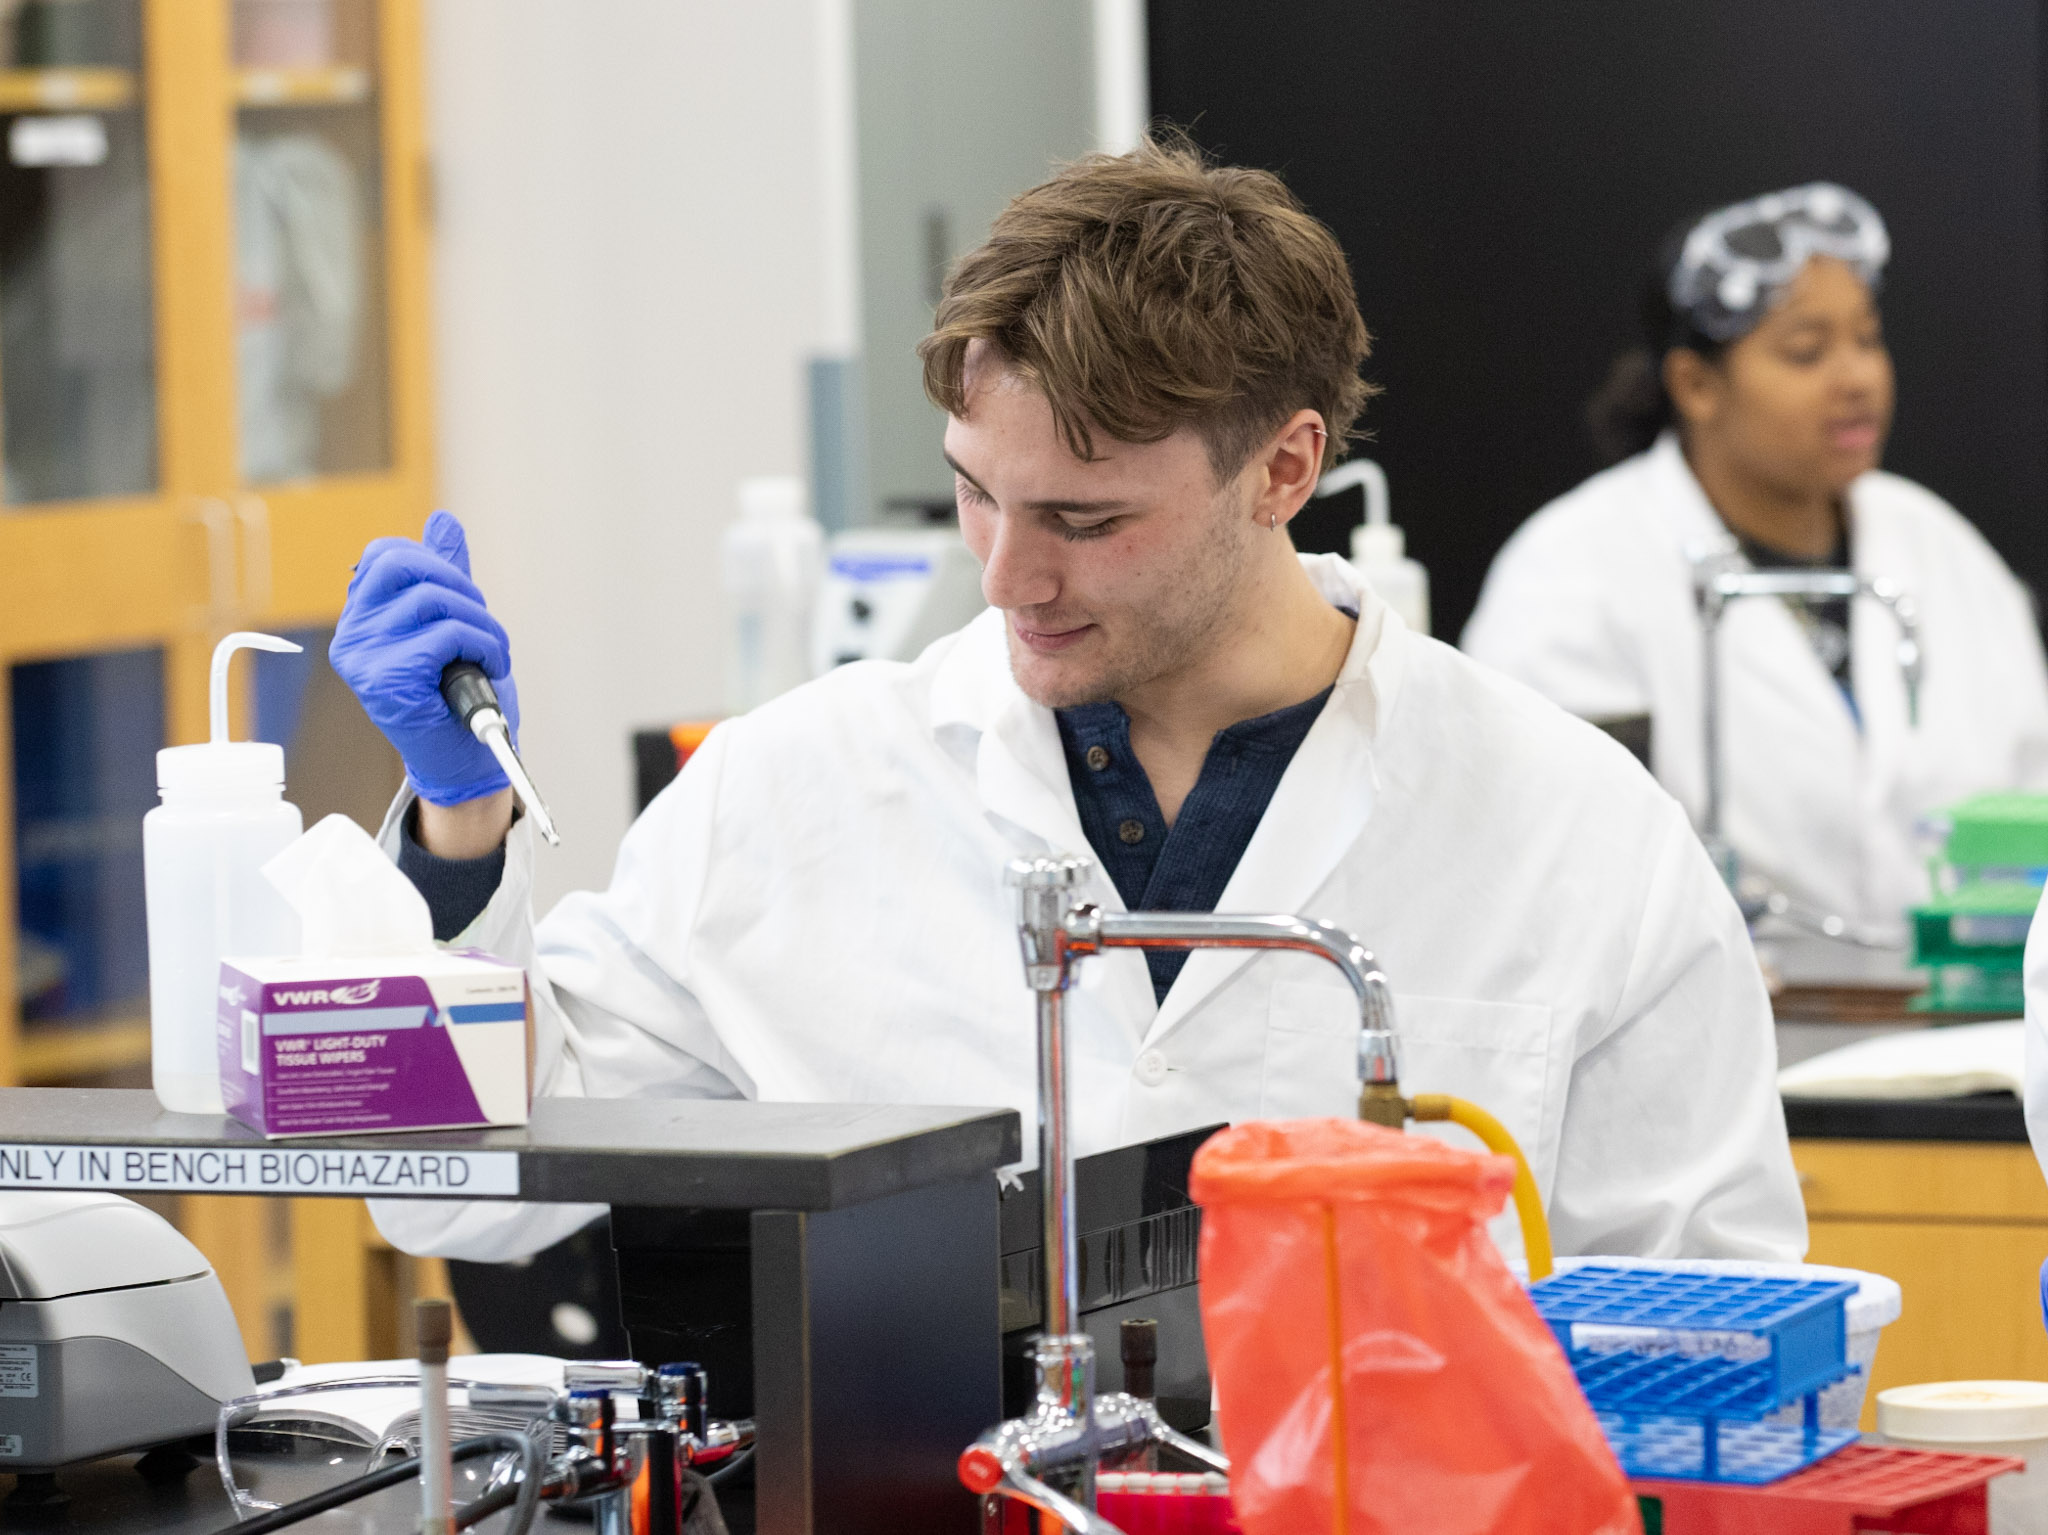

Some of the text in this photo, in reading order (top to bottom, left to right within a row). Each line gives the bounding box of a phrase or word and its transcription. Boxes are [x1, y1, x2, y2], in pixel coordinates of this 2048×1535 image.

[273, 990, 330, 1007] VWR
[313, 1035, 389, 1051] LIGHT-DUTY
[275, 1049, 367, 1067] TISSUE WIPERS
[79, 1151, 110, 1182] IN
[125, 1152, 246, 1184] BENCH
[260, 1154, 470, 1187] BIOHAZARD
